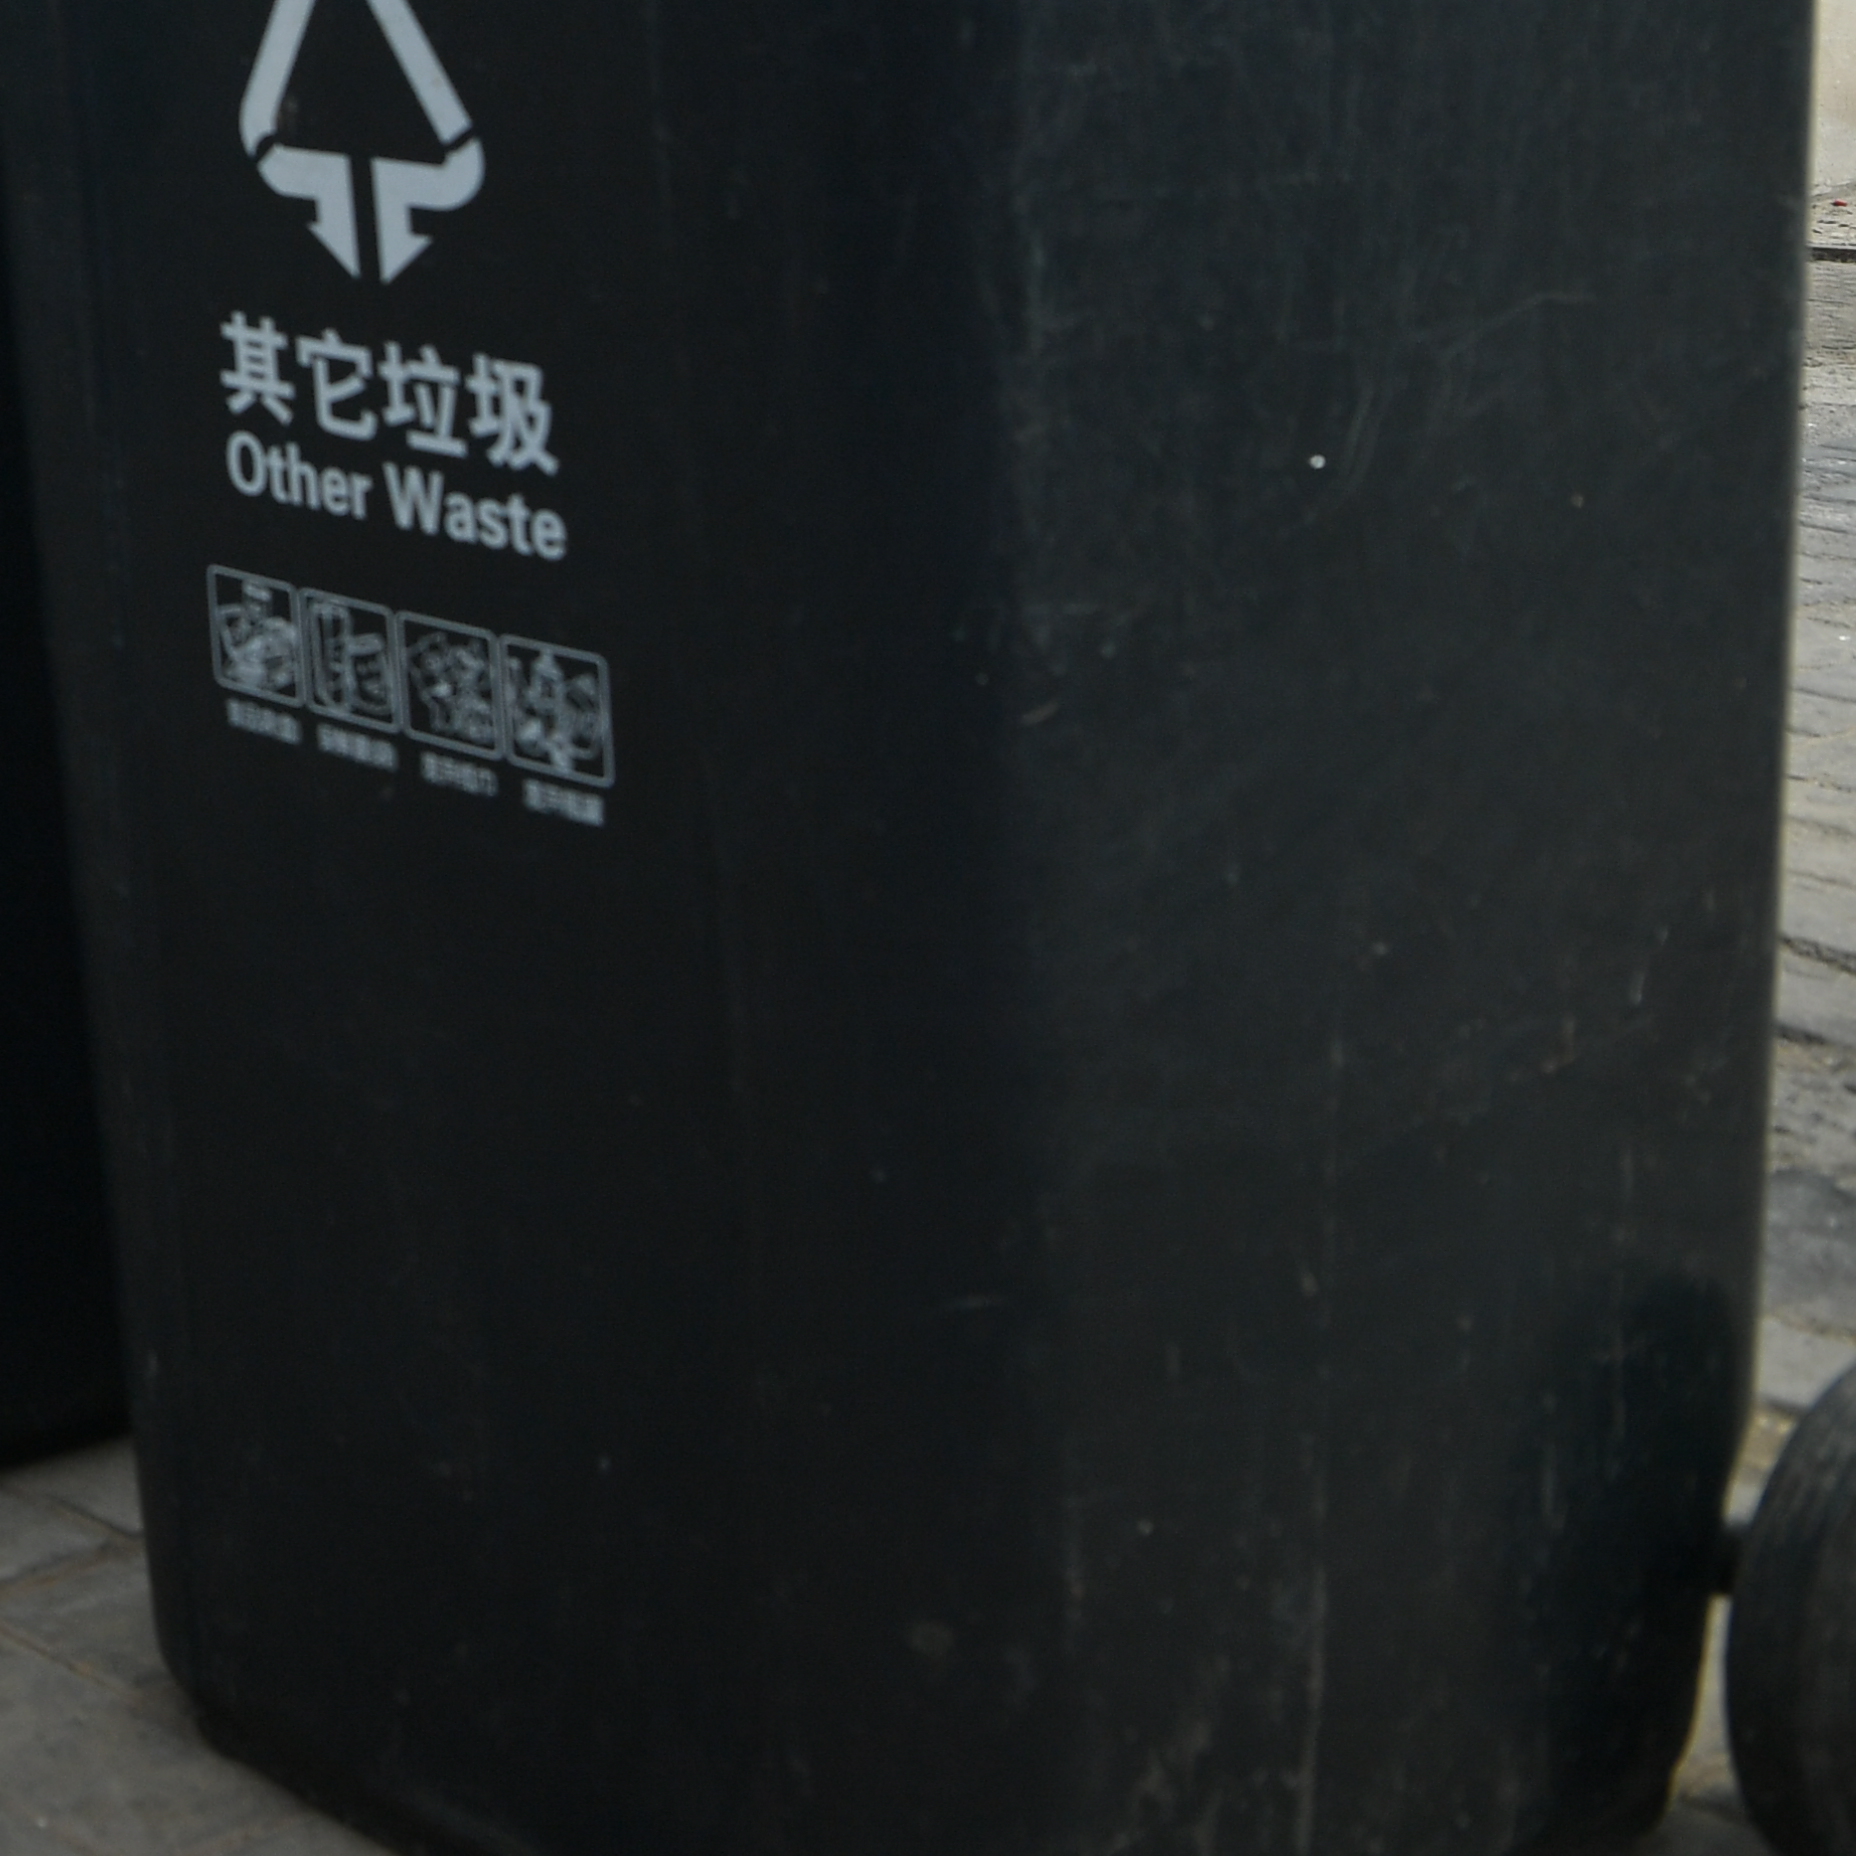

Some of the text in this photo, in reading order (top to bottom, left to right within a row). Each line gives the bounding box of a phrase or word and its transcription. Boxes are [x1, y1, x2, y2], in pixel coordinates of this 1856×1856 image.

[221, 311, 559, 477] 其它垃圾
[224, 430, 569, 560] Other Waste
